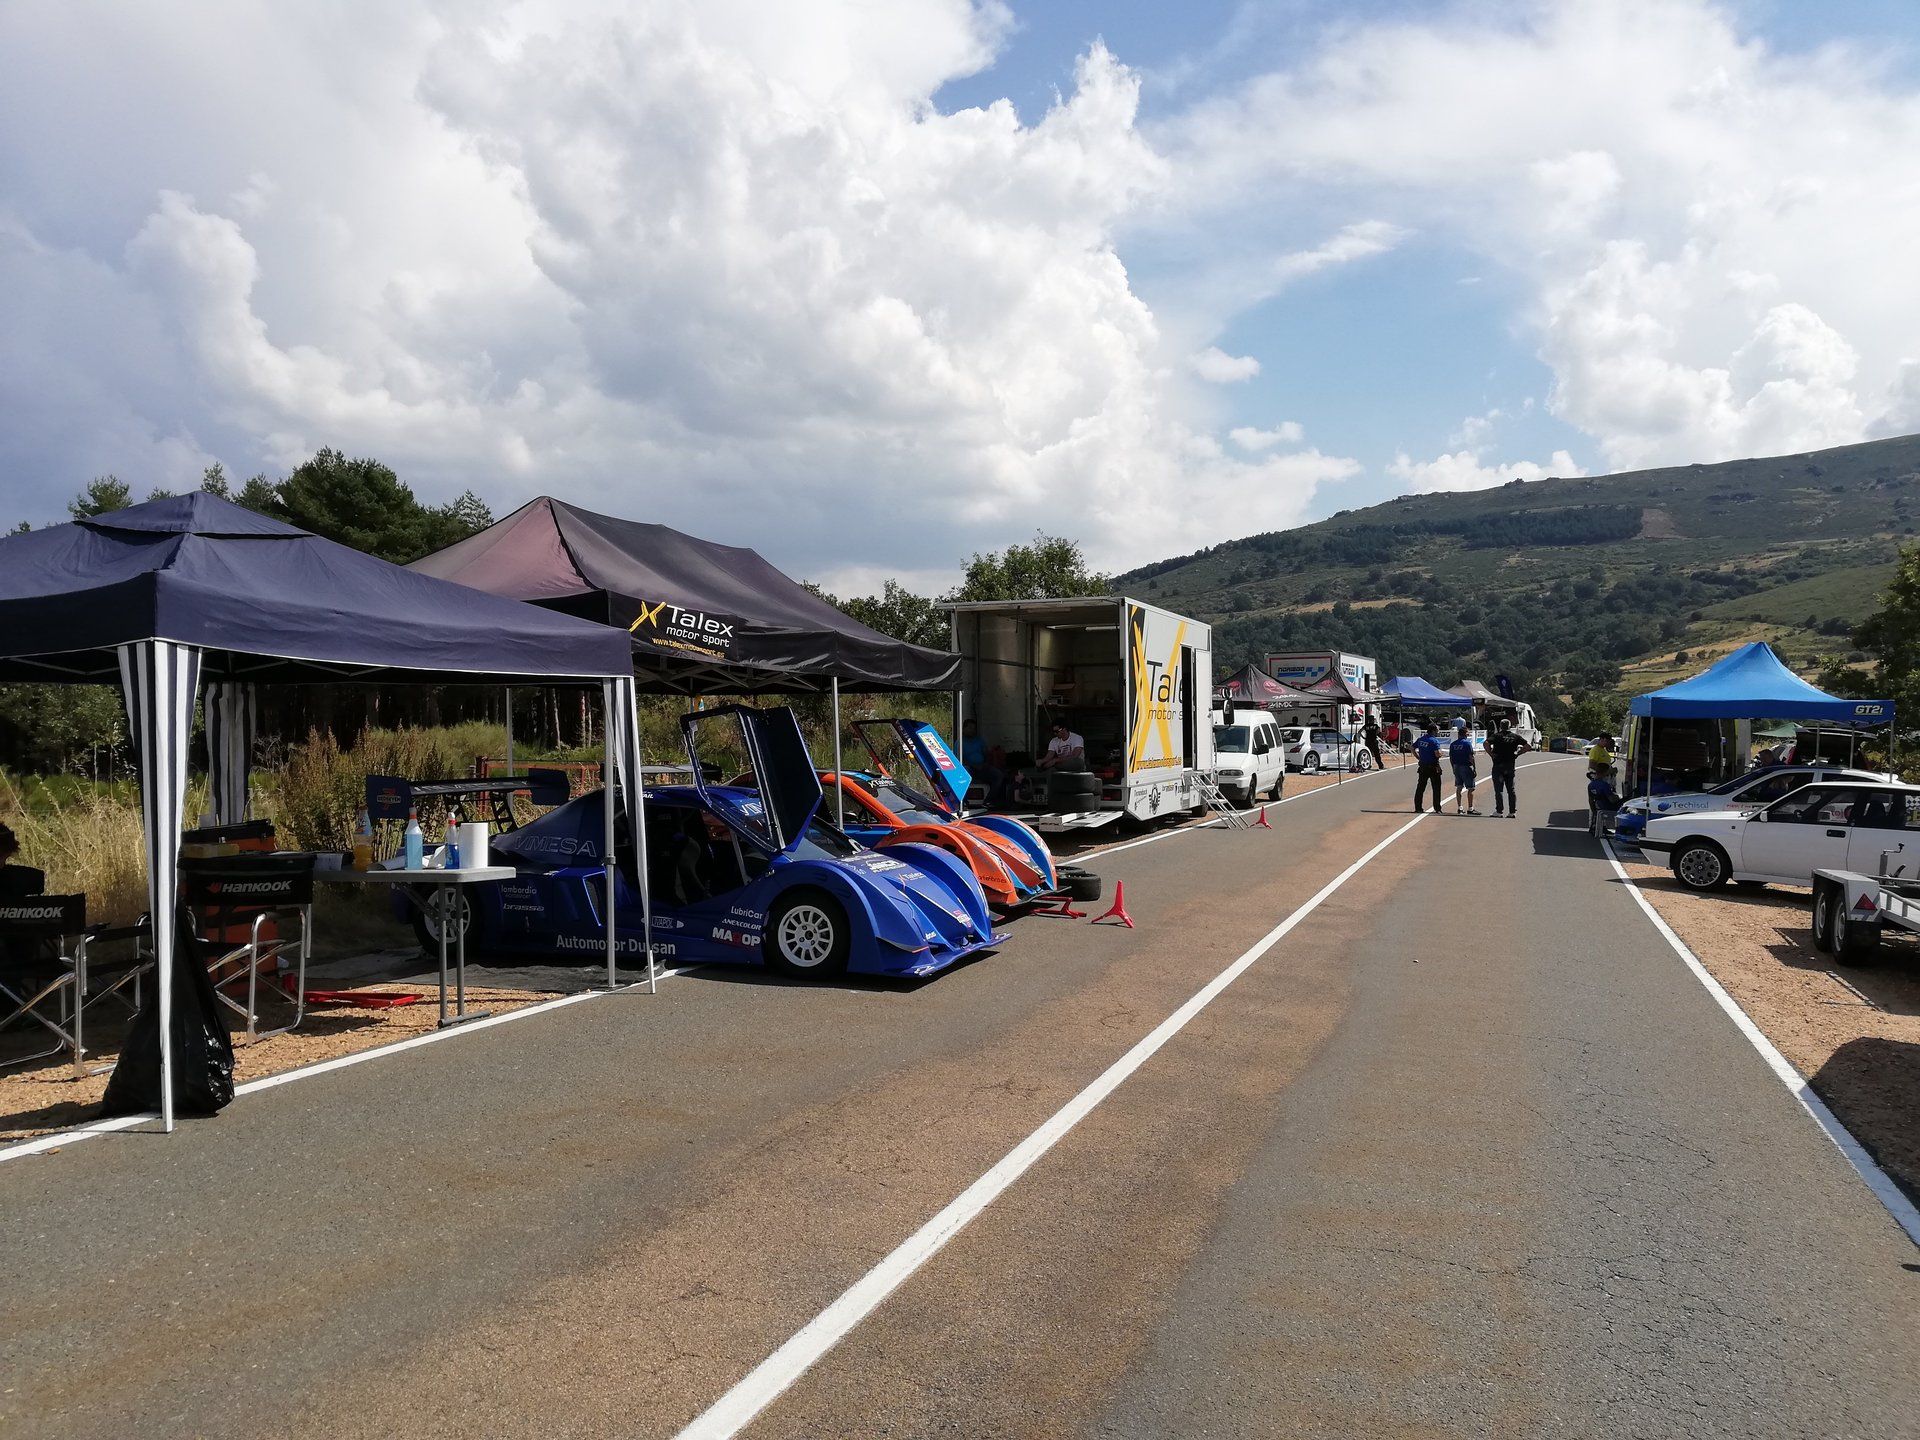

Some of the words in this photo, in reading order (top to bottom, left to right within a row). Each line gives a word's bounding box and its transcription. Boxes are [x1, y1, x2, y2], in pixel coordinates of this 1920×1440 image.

[667, 604, 734, 637] Talex
[666, 626, 700, 640] motor
[702, 633, 730, 648] sport
[1146, 660, 1183, 704] Tal
[1147, 709, 1177, 720] motor
[556, 934, 626, 951] Automoor
[628, 938, 676, 955] Dusan
